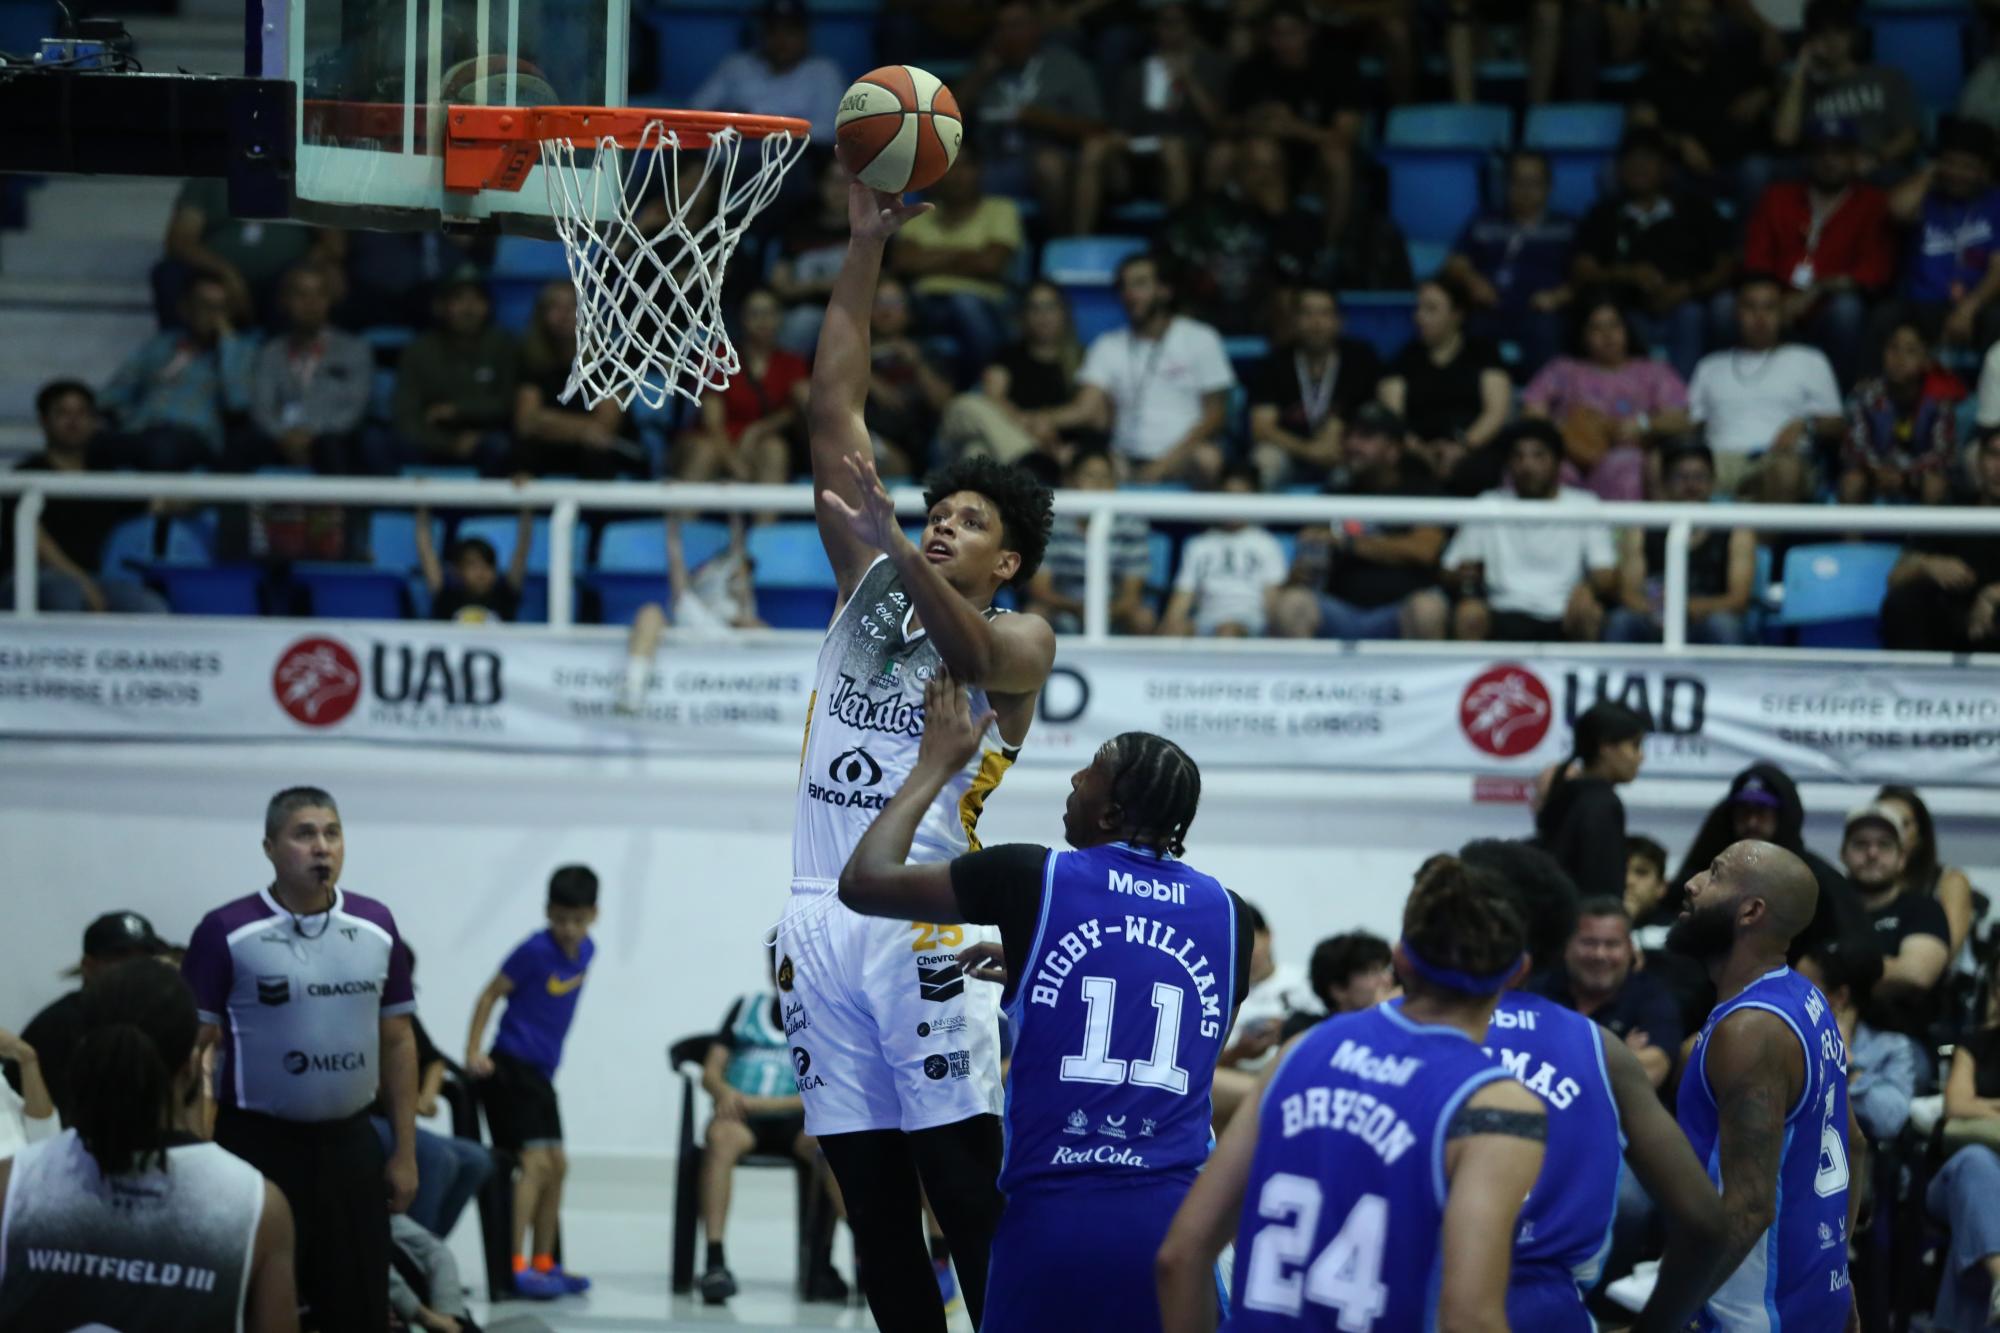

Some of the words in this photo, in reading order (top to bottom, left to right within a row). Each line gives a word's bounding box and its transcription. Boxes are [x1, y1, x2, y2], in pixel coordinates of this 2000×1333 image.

[95, 649, 222, 674] GRANDES
[111, 682, 201, 704] LOBOS
[1147, 680, 1261, 701] SIEMPRE
[1271, 681, 1405, 704] GRANDES
[1761, 692, 1885, 716] SIEMPRE
[1163, 711, 1277, 732] SIEMPRE
[1288, 713, 1383, 734] LOBOS
[1777, 727, 1901, 749] SIEMPRE
[1108, 869, 1187, 905] Mobil
[1031, 914, 1220, 1040] BIGBY-WILLIAMS
[1059, 975, 1189, 1096] 11
[310, 1052, 366, 1072] MEGA
[1329, 1039, 1420, 1087] Mobil
[1243, 1172, 1390, 1333] 24
[27, 1248, 182, 1287] WHITFIELD
[184, 1268, 216, 1292] III
